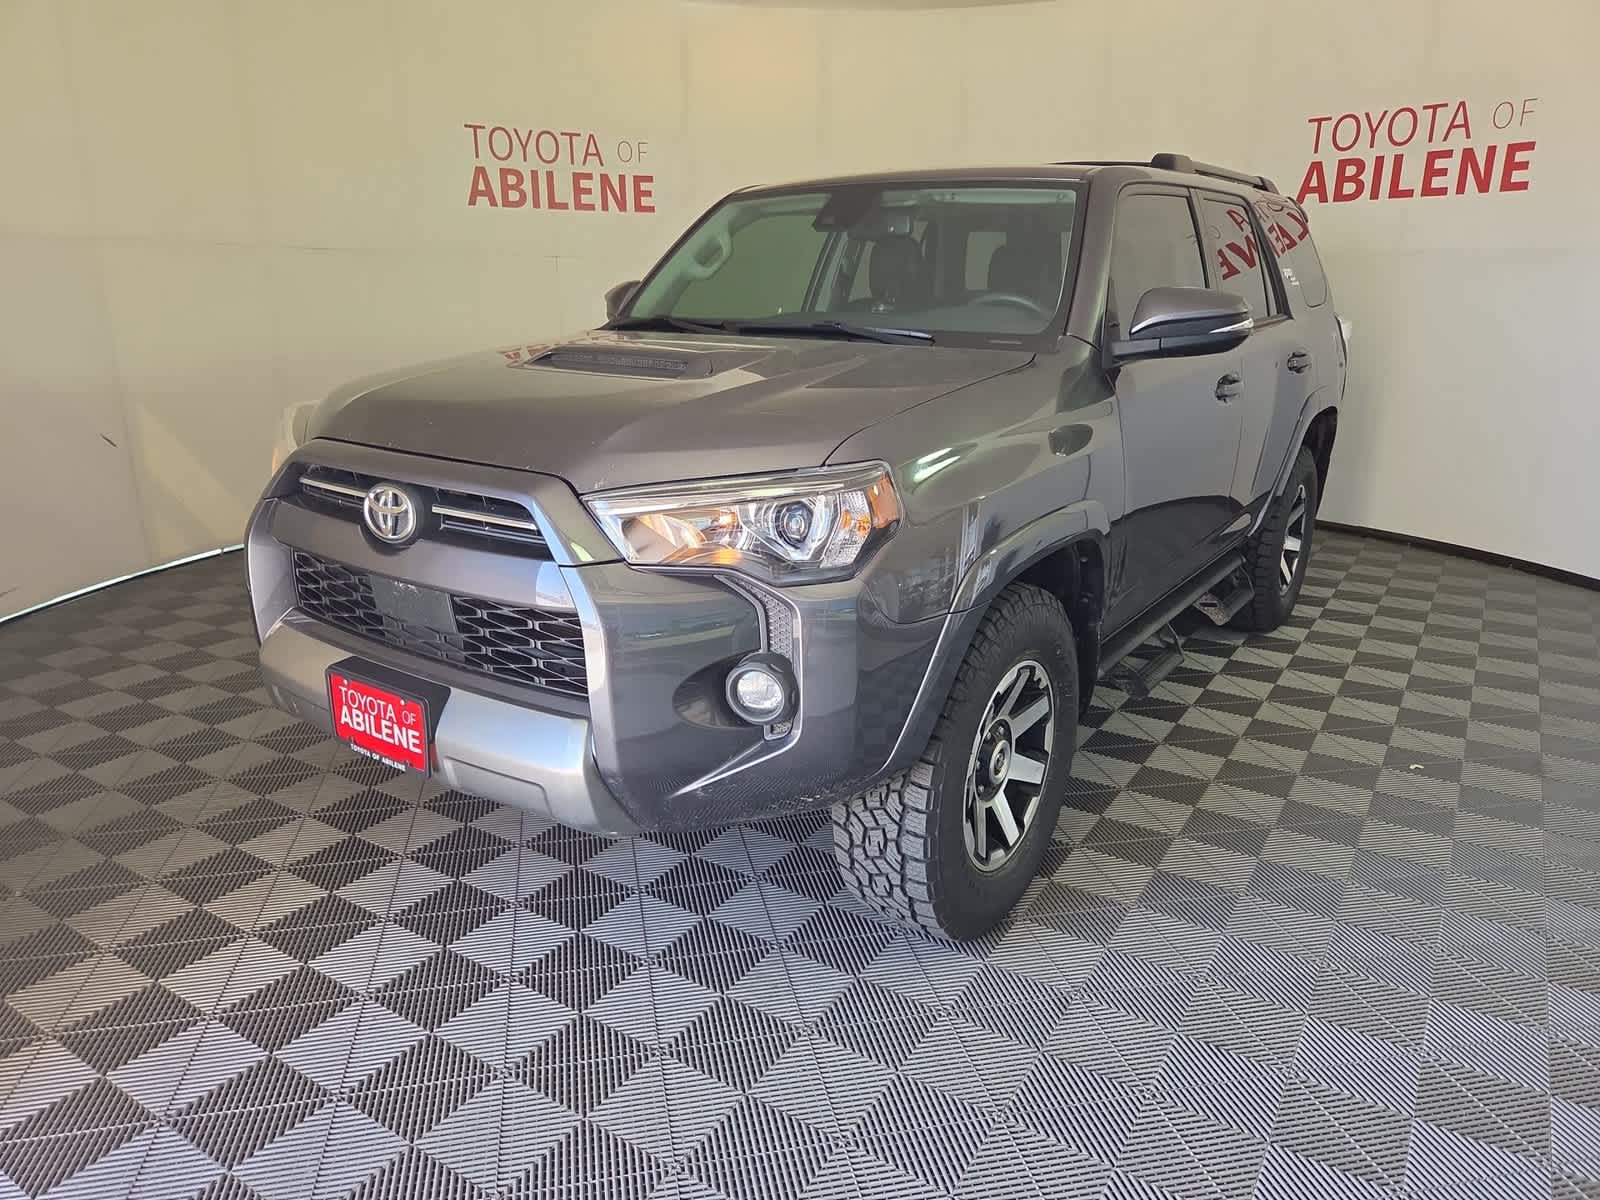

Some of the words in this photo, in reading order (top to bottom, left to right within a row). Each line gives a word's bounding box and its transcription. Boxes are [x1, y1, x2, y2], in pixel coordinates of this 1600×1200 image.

[464, 124, 604, 167] TOYOTA
[617, 140, 648, 163] OF
[1308, 101, 1472, 154] TOYOTA
[1493, 98, 1538, 129] OF
[467, 165, 656, 213] ABILENE
[1296, 141, 1537, 204] ABILENE
[339, 685, 397, 722] TOYOTA
[402, 710, 416, 725] OF
[341, 704, 422, 754] ABILENE
